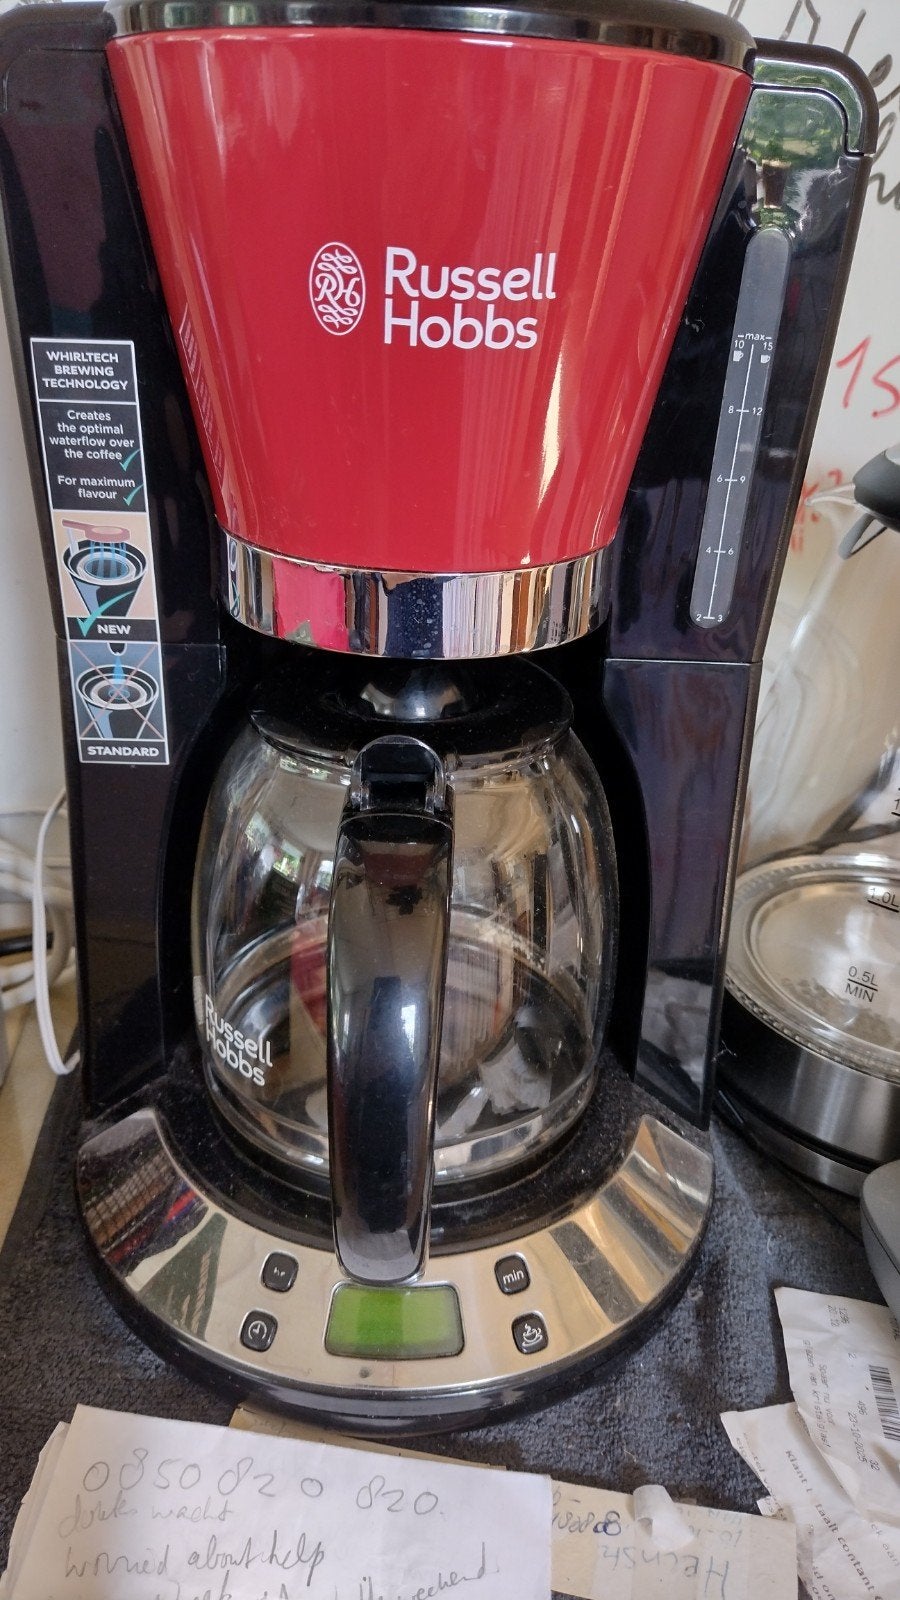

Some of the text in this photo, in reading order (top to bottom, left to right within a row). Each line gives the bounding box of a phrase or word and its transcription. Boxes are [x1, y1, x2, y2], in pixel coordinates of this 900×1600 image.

[385, 246, 557, 301] Russell
[384, 298, 539, 350] Hobbs
[745, 333, 765, 341] max
[734, 340, 773, 351] 10 15
[46, 351, 119, 363] WHIRLTECH
[54, 365, 115, 377] BREWING
[42, 378, 128, 391] TECHNOLOGY
[67, 410, 111, 421] Creates
[728, 406, 763, 416] 8 12
[57, 422, 124, 435] the optimal
[49, 435, 135, 448] waterflow over
[64, 448, 123, 460] the coffee
[57, 475, 136, 488] For maximum
[717, 475, 746, 483] 6 9
[77, 488, 118, 499] flavour
[728, 548, 734, 556] 6
[696, 614, 723, 622] 2 3
[97, 623, 131, 635] NEW
[87, 745, 160, 758] STANDARD
[848, 965, 878, 987] 0.5L
[845, 983, 876, 1003] MIN
[205, 993, 273, 1068] Russell
[205, 1018, 266, 1087] Hobbs
[502, 1268, 525, 1286] min
[83, 1448, 202, 1492] 0850
[187, 1534, 258, 1570] about
[838, 1537, 875, 1591] contant
